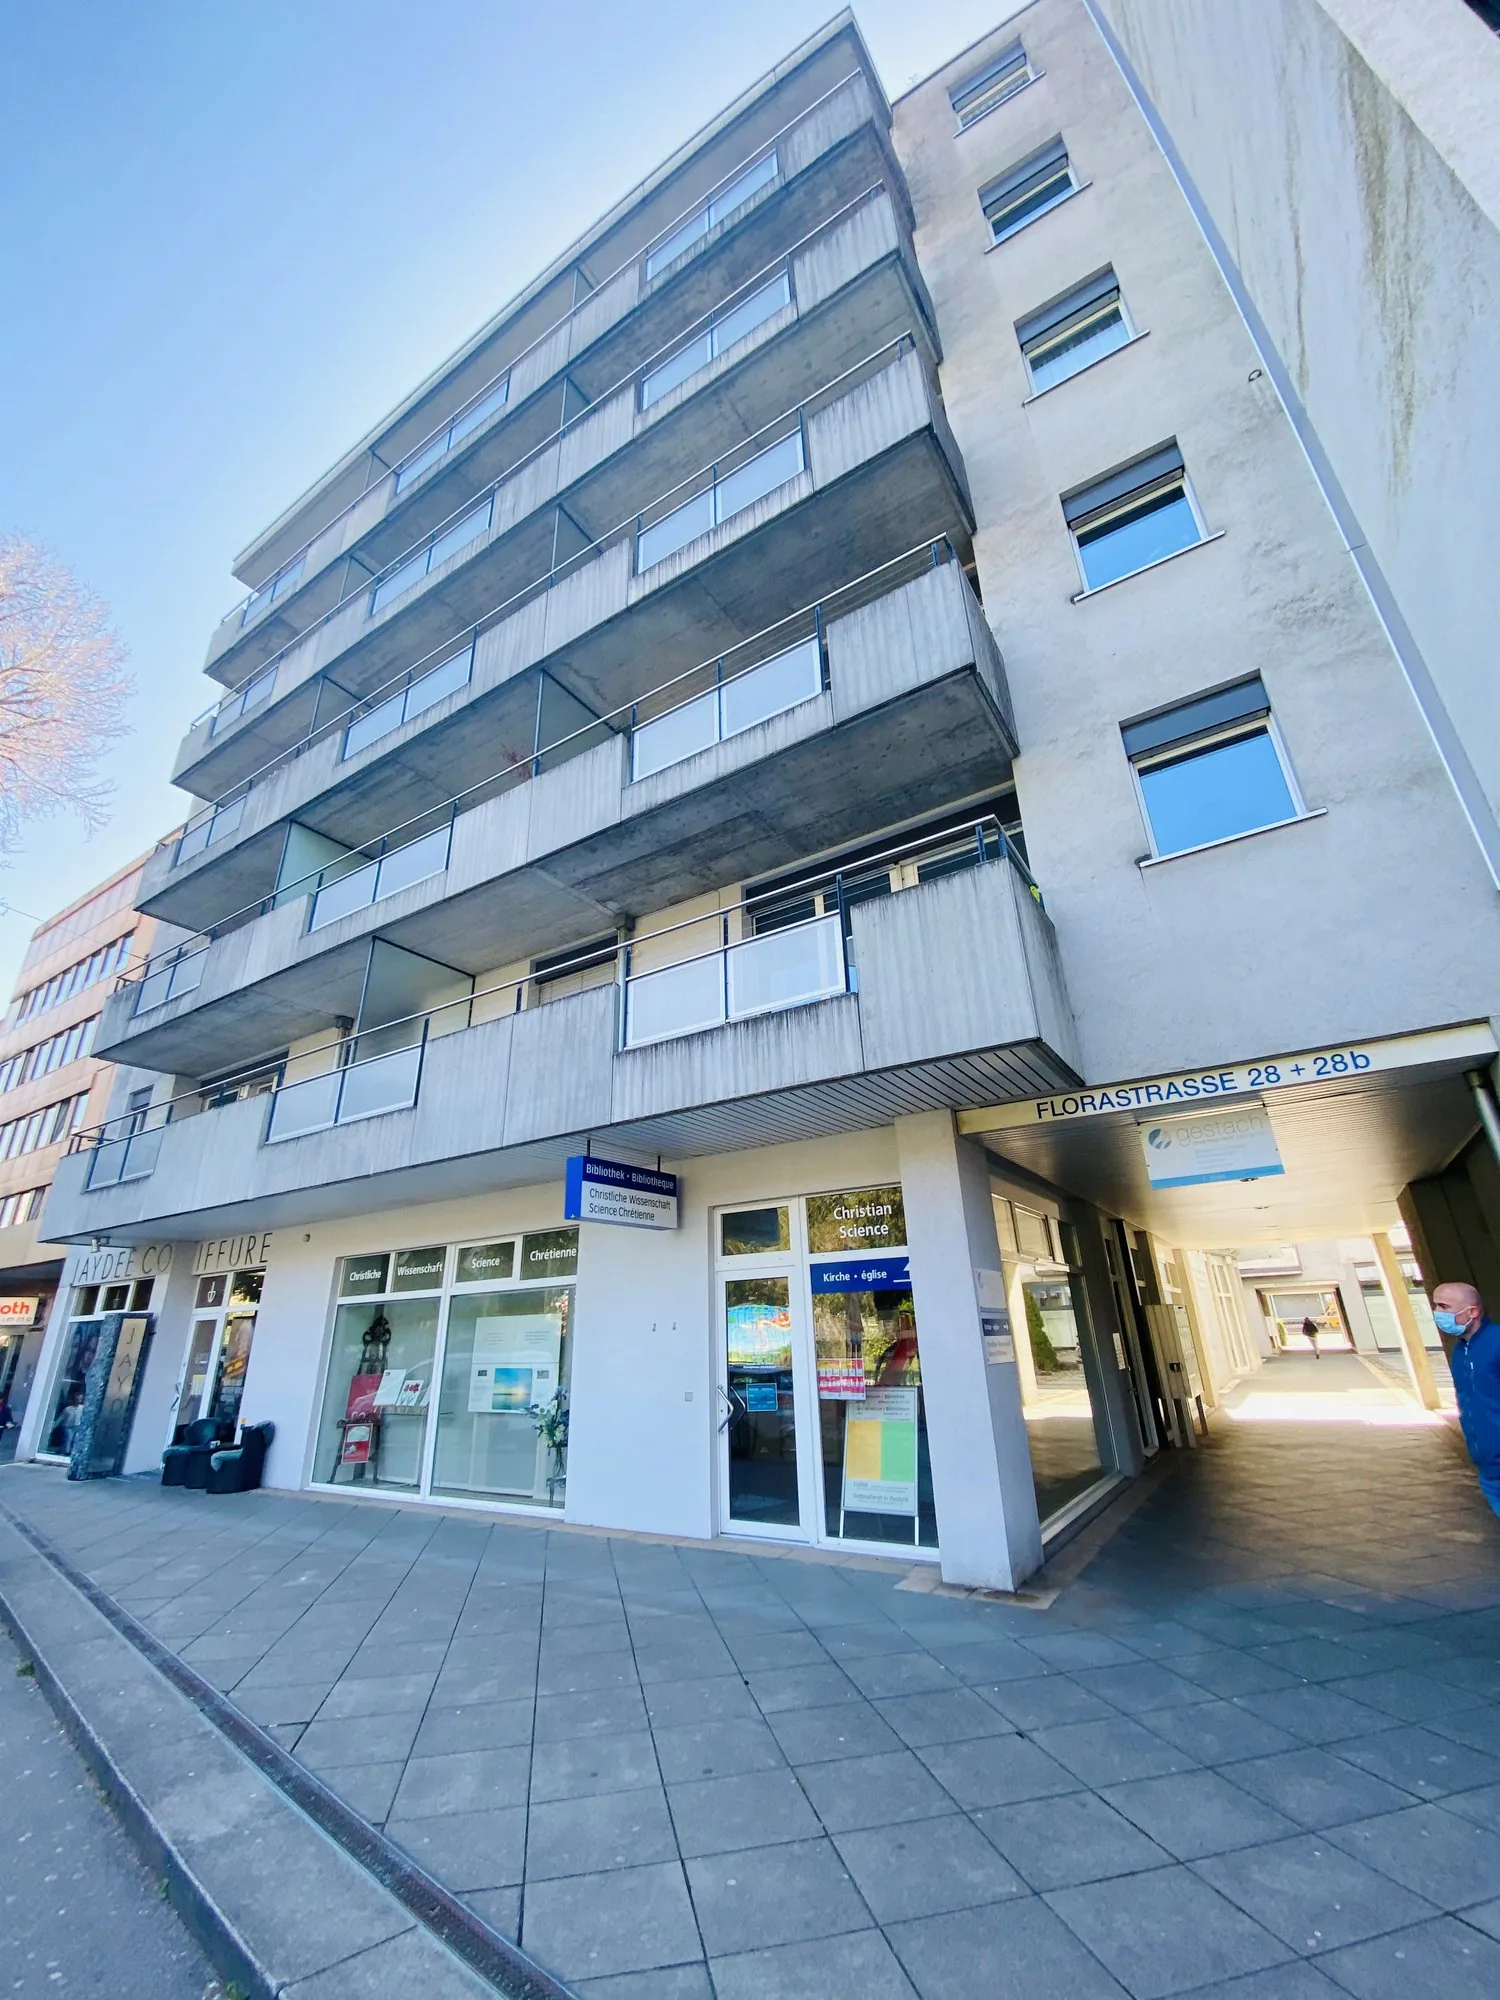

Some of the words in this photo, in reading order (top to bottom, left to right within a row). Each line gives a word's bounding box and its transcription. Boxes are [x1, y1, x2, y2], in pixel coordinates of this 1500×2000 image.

[1036, 1072, 1238, 1120] FLORASTRASSE
[1247, 1065, 1281, 1087] 28
[1313, 1050, 1371, 1076] 28b
[1176, 1113, 1264, 1147] gestach
[586, 1163, 625, 1180] Bibliothek
[589, 1187, 628, 1204] Christliche
[628, 1195, 671, 1211] Wissenschaft
[589, 1202, 618, 1217] Science
[618, 1206, 655, 1221] Chrétienne
[833, 1202, 892, 1220] Christian
[839, 1223, 889, 1239] Science
[471, 1256, 500, 1269] Science
[529, 1246, 577, 1262] Chrétienne
[72, 1248, 137, 1285] JAYDEE
[397, 1260, 443, 1277] Wissenschaft
[349, 1269, 382, 1282] Christliche
[823, 1271, 851, 1283] Kirche
[861, 1268, 888, 1282] église
